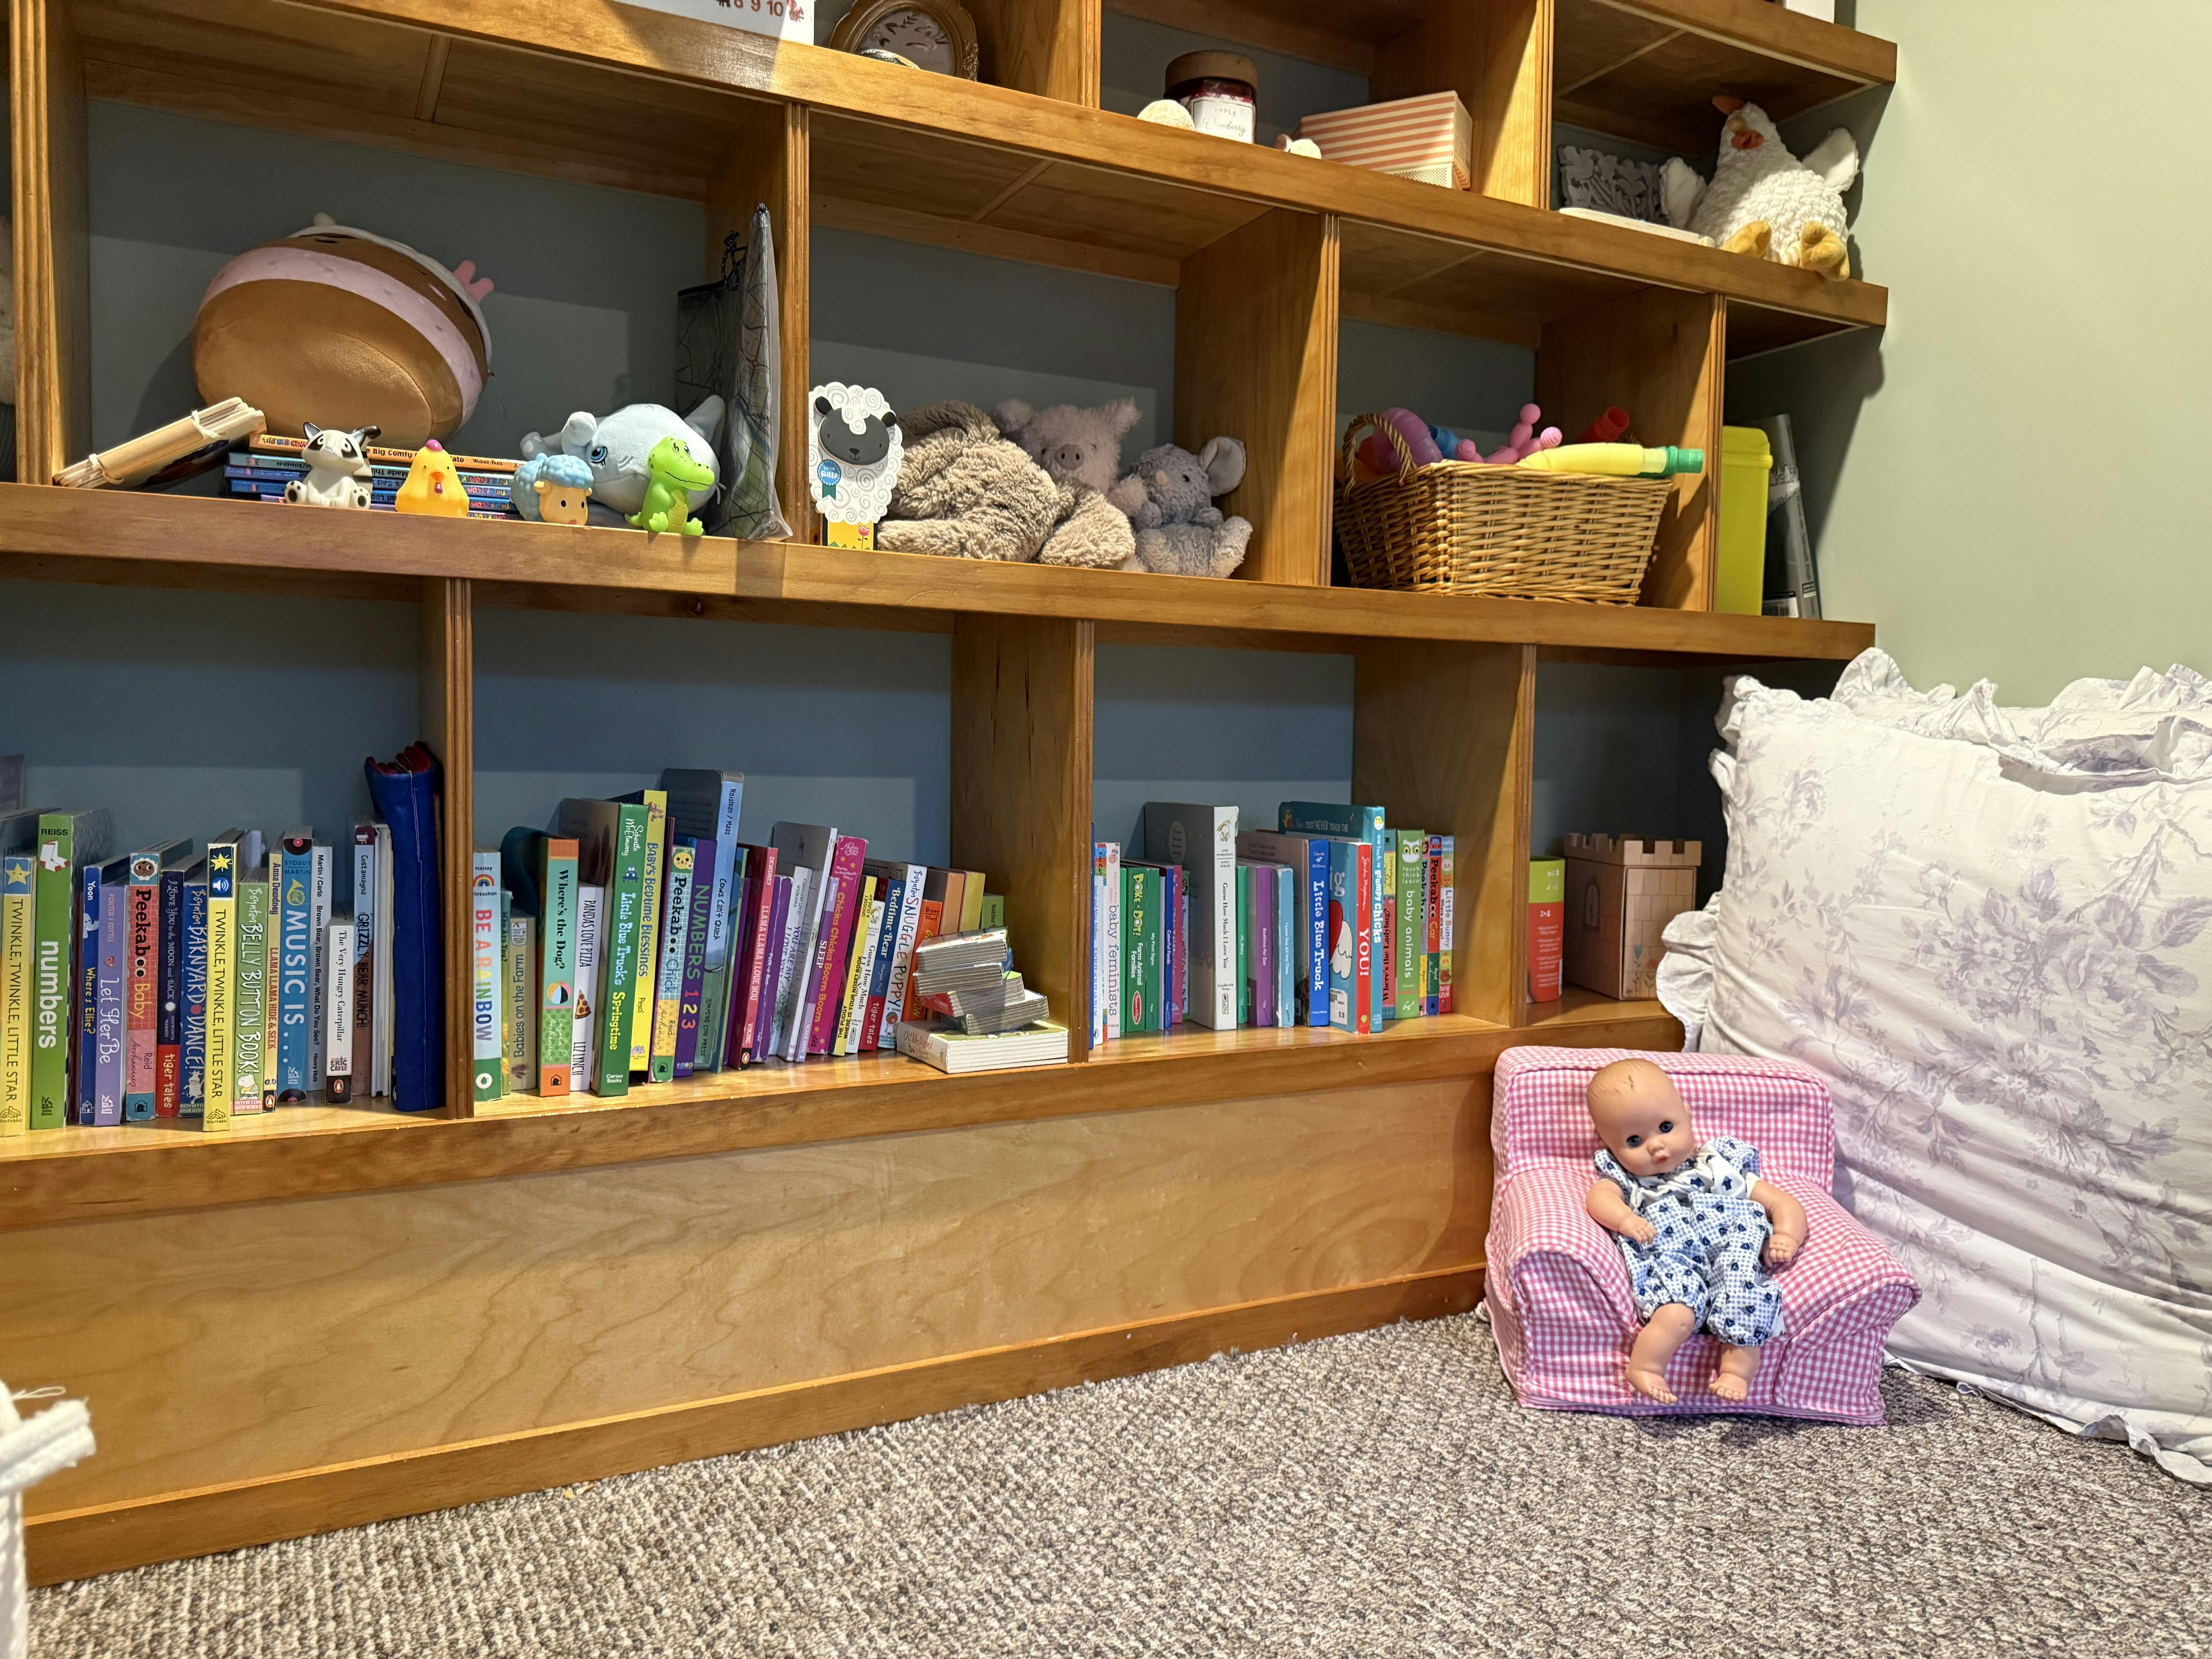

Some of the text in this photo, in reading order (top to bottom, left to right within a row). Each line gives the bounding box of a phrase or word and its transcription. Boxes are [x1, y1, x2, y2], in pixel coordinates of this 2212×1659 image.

[767, 0, 784, 17] 10
[1203, 117, 1247, 137] Cranberry
[388, 450, 412, 459] Comfy
[273, 862, 281, 881] Anna
[646, 842, 659, 876] BABY'S
[269, 883, 280, 914] Dewdney
[554, 869, 569, 969] Where's the Dog?
[716, 878, 727, 918] Cows Can't
[886, 887, 901, 930] Bedtime
[1106, 904, 1120, 938] baby
[1132, 873, 1145, 936] POKE DOT!
[1373, 869, 1384, 943] grumpy chicks
[1429, 858, 1439, 940] Peekaboo Car
[84, 880, 96, 1035] Yoon Where's Ellie?
[129, 889, 151, 1020] Peekaboo Baby
[269, 947, 278, 974] LLAMA
[284, 910, 307, 994] MUSIC
[355, 855, 371, 1030] Costamagna GRIZZLY BEAR MUNCH!
[664, 876, 686, 993] Peekaboo Chick
[687, 884, 710, 980] NUMBERS
[745, 856, 775, 1044] DEWDNEY LLAMA LLAMA LOVE YOU VIKING
[785, 926, 801, 982] YOU ARE MY
[814, 891, 845, 1022] Chicka Chicka Boom Boom
[816, 940, 828, 969] SLEEP
[880, 932, 891, 958] Bear
[887, 870, 923, 1012] Boynton SNUGGLE PUPPY!
[1314, 881, 1325, 991] Little Blue Truck
[1359, 927, 1370, 976] YOU!
[1404, 890, 1415, 978] baby animals
[1444, 921, 1452, 948] Bunny
[6, 899, 24, 1103] TWINKLE, TWINKLE, LITTLE STAR
[38, 941, 63, 1049] numbers
[185, 889, 207, 1068] Boynton BARNYARD DANCE!
[238, 887, 263, 1073] Boynton BELLY BUTTON BOOK!
[269, 976, 278, 1003] LLAMA
[335, 930, 348, 1042] The Very Hungry Caterpillar
[476, 909, 493, 1041] BE A RAINBOW
[572, 900, 596, 1076] PANDAS LOVE PIZZA LIZ LYNCH
[608, 892, 636, 1050] Little Blue Truck's Springtime
[858, 945, 876, 1009] Guess How Much
[1108, 944, 1120, 1016] feminists
[100, 978, 120, 1065] Let Her Be
[211, 908, 227, 1099] TWINKLE, TWINKLE, LITTLE STAR
[268, 1004, 277, 1021] HIDE
[314, 1005, 320, 1015] Do
[514, 953, 525, 1058] Babies on the Farm
[667, 1020, 676, 1035] Reid
[681, 1018, 696, 1029] 3
[683, 1003, 697, 1014] 2
[866, 1024, 876, 1044] tales
[870, 1003, 881, 1023] tiger
[144, 1053, 152, 1070] Reid
[268, 1030, 276, 1050] SEEK
[160, 1053, 176, 1108] tiger tales
